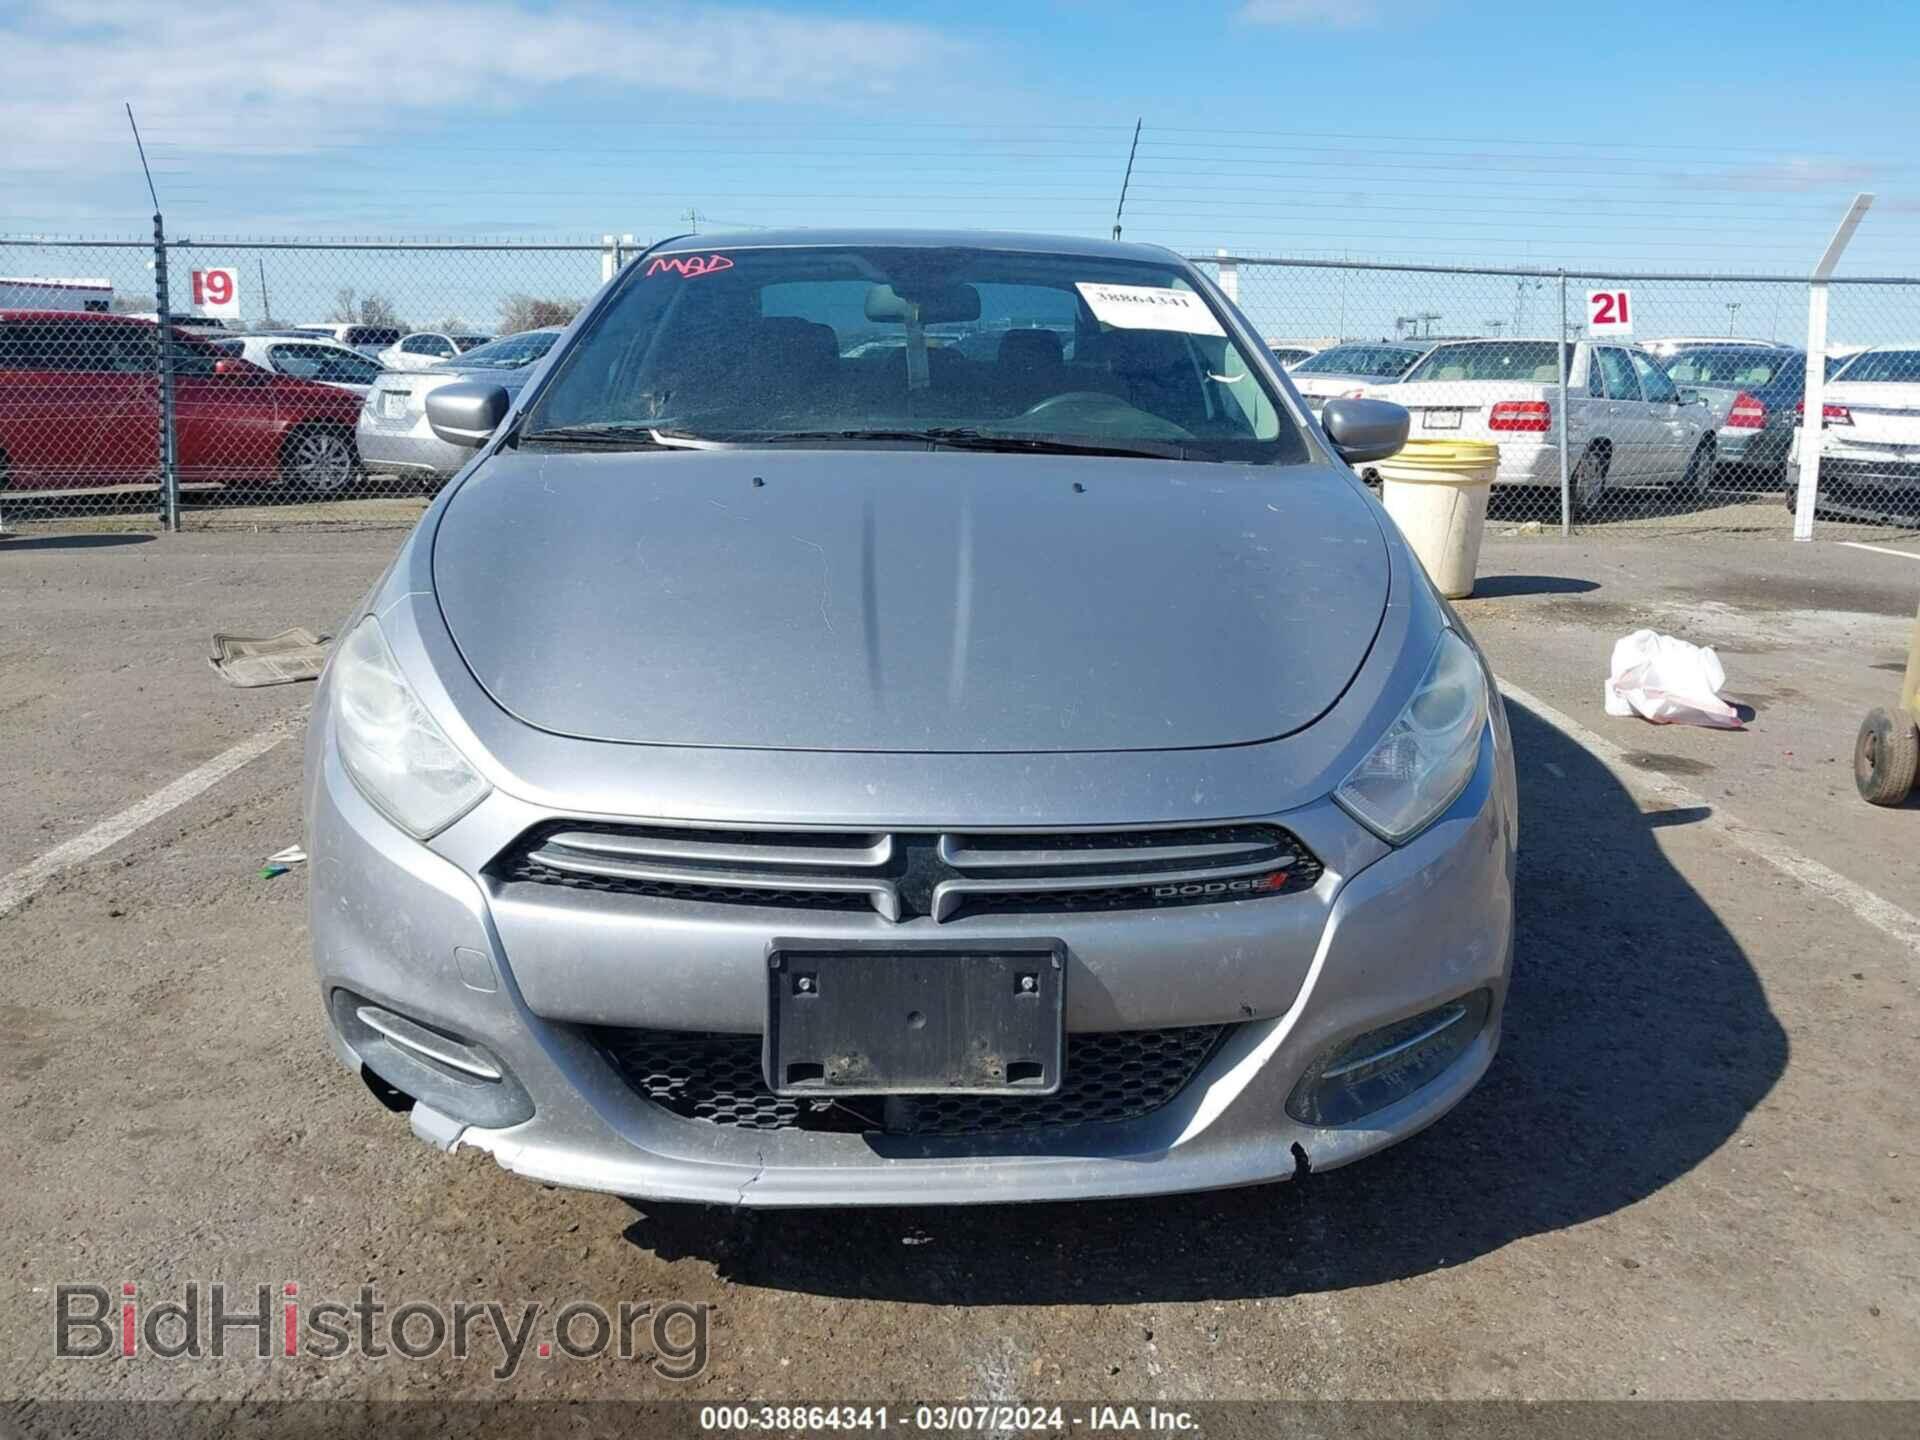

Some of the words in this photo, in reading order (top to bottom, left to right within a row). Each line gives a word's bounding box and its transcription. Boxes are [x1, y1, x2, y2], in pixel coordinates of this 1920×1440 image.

[192, 270, 233, 305] 19
[1096, 291, 1190, 308] 38864341
[1592, 293, 1628, 323] 21
[1154, 878, 1273, 897] DODGE
